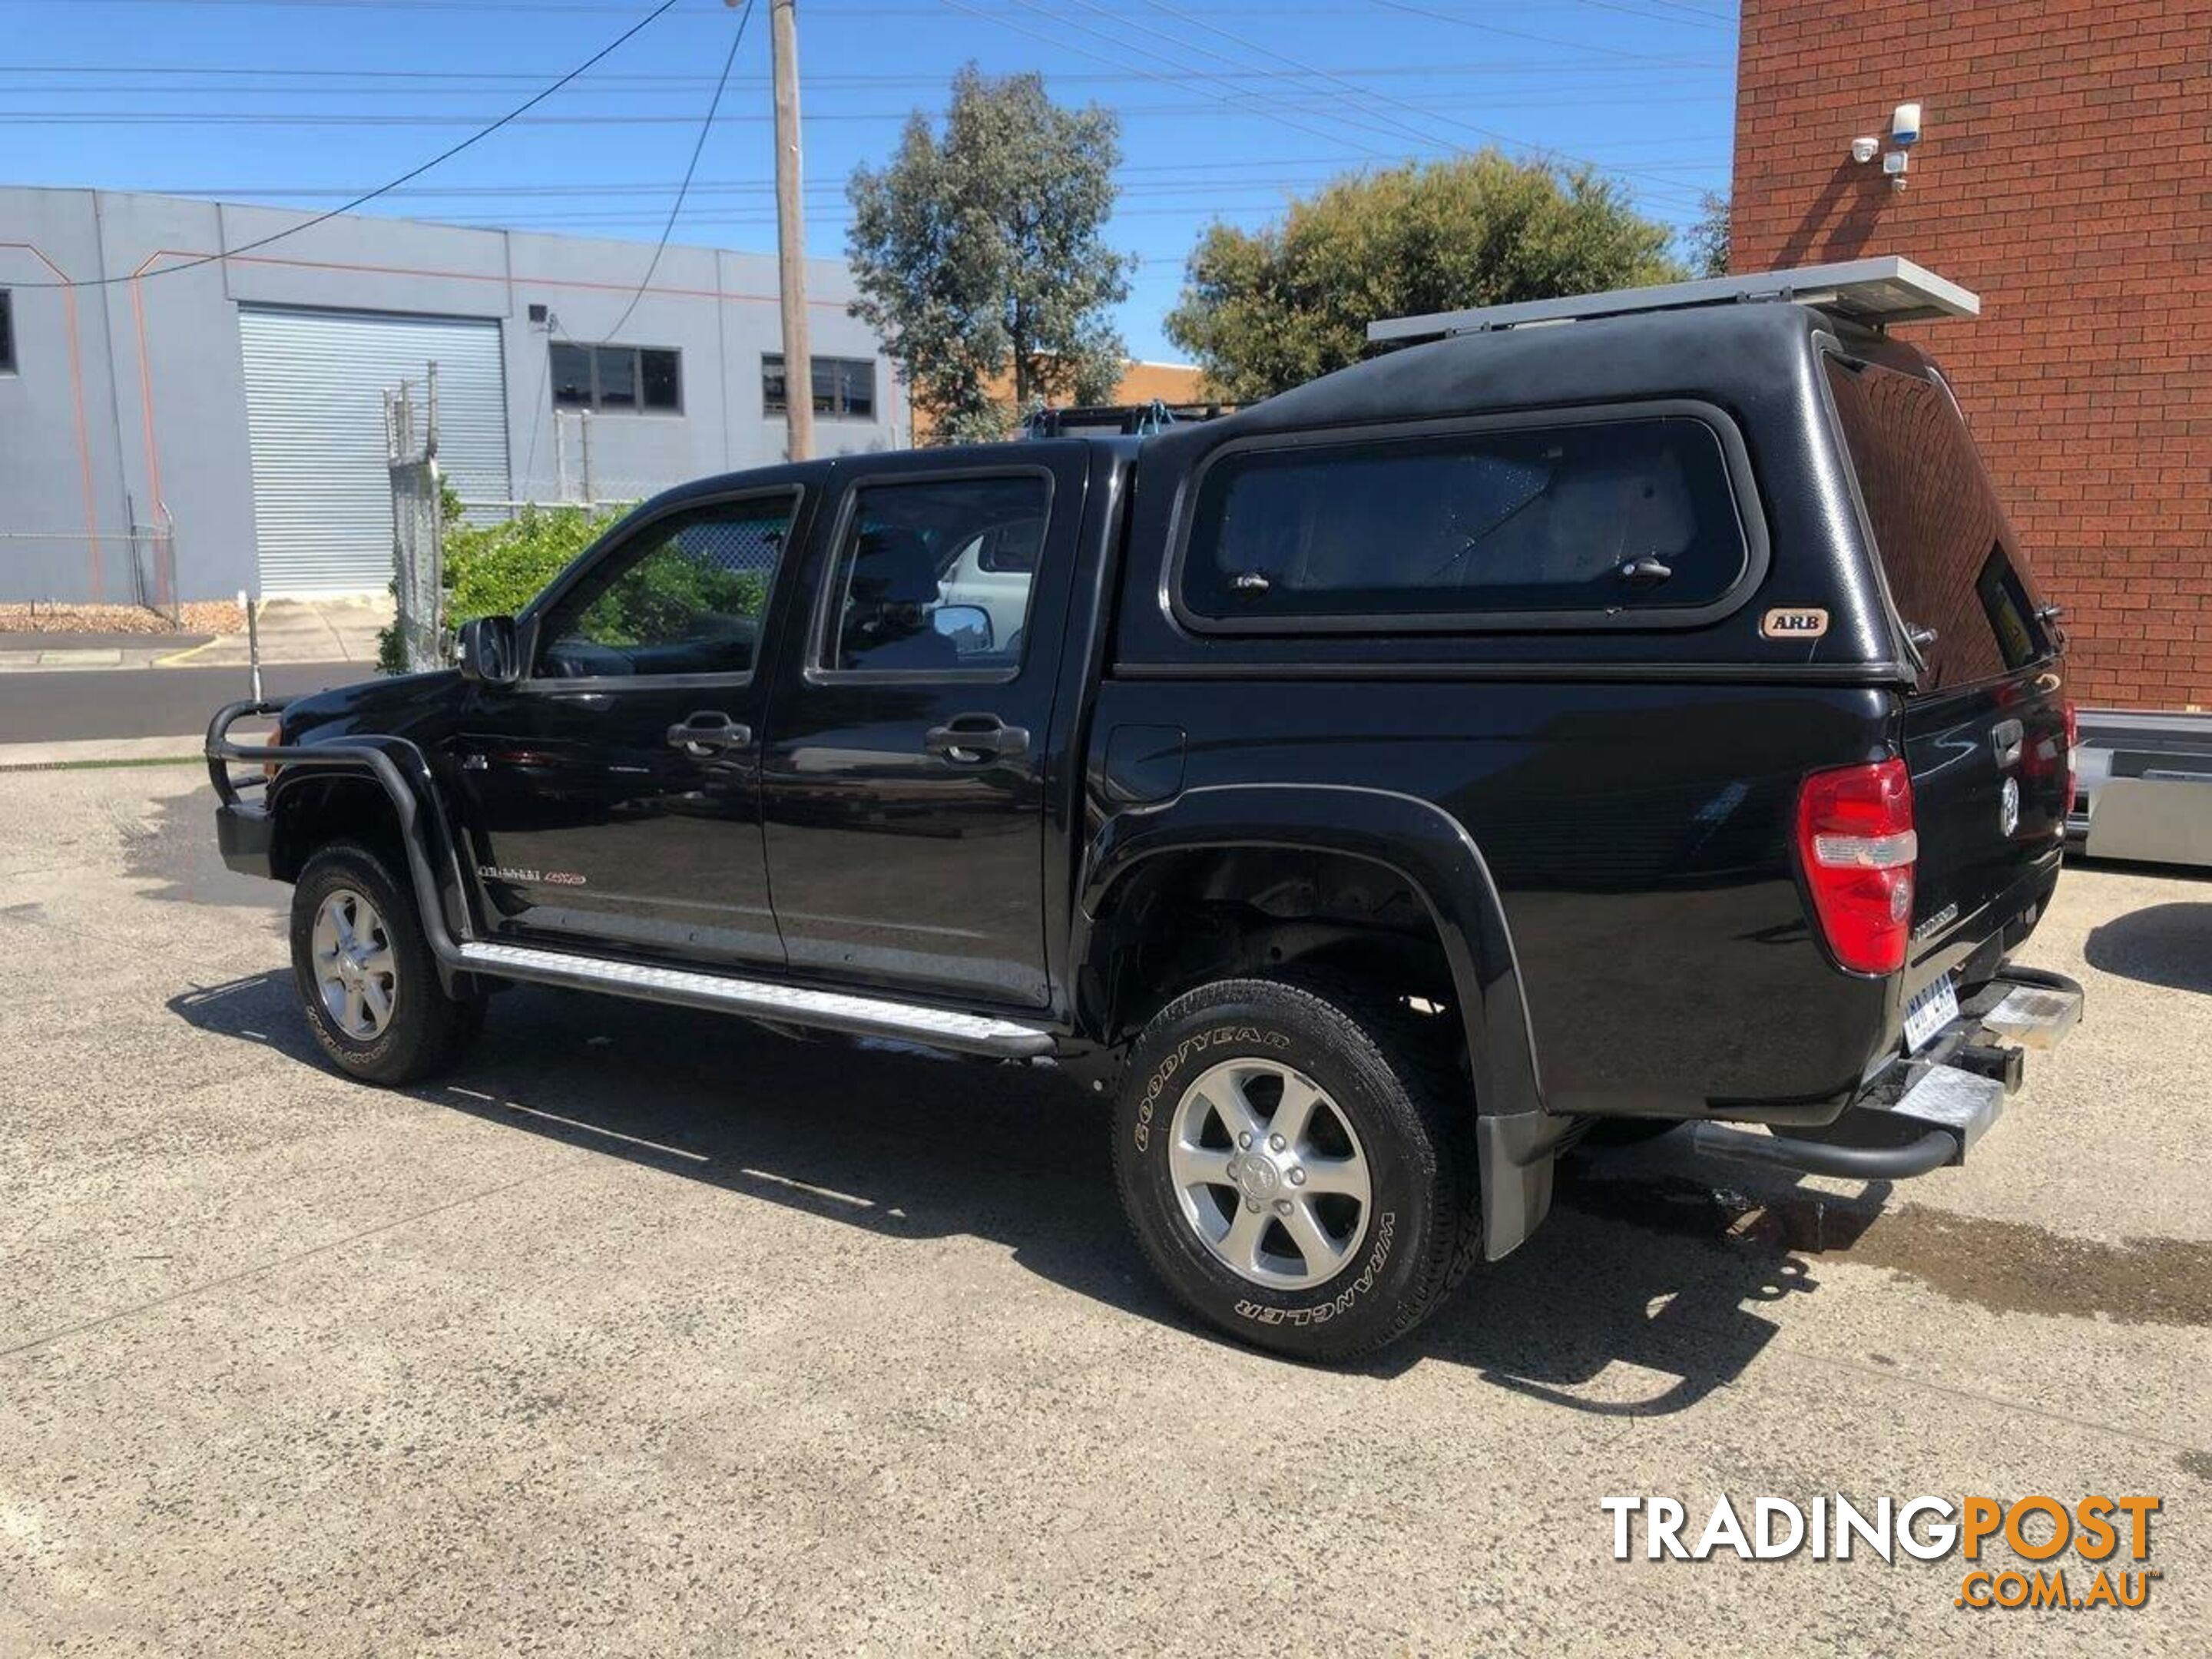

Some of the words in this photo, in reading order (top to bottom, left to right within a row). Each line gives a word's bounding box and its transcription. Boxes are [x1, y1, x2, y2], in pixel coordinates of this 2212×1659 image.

[1772, 615, 1820, 630] ARB
[1134, 1026, 1291, 1153] GOODYEAR
[1234, 1211, 1396, 1326] WRANGLER
